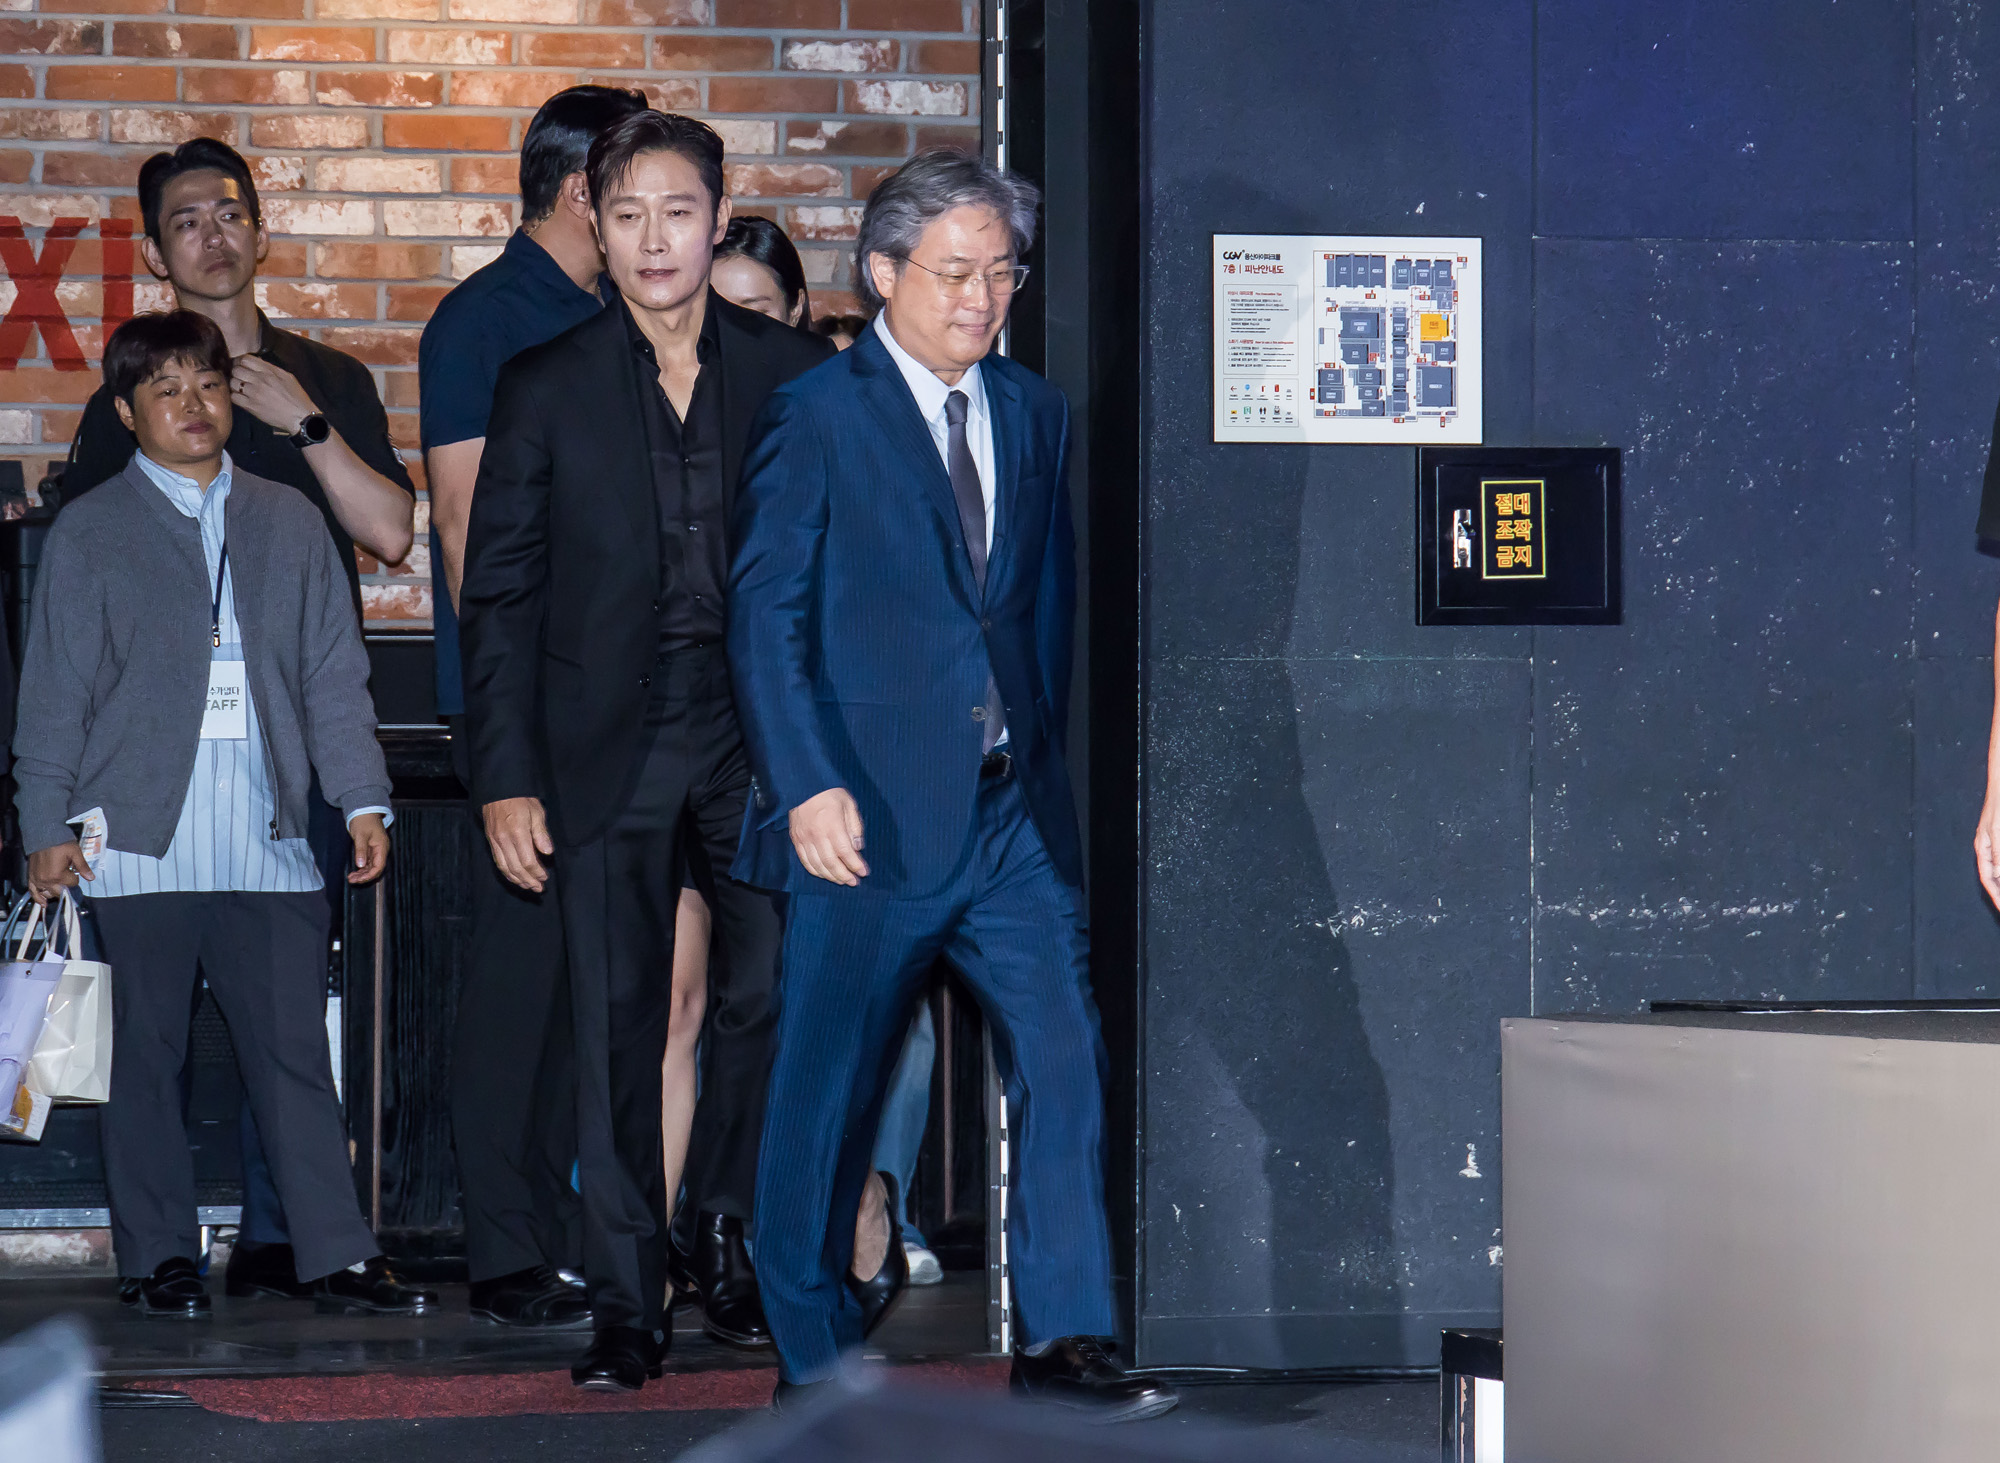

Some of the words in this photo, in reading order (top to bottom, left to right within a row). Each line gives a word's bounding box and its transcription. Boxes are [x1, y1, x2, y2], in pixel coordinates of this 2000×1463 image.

[1223, 251, 1242, 260] CGV
[1223, 264, 1236, 274] 7층
[1245, 264, 1284, 274] 피난안내도
[1495, 493, 1531, 515] 절대
[1495, 519, 1532, 541] 조작
[1496, 545, 1532, 568] 금지
